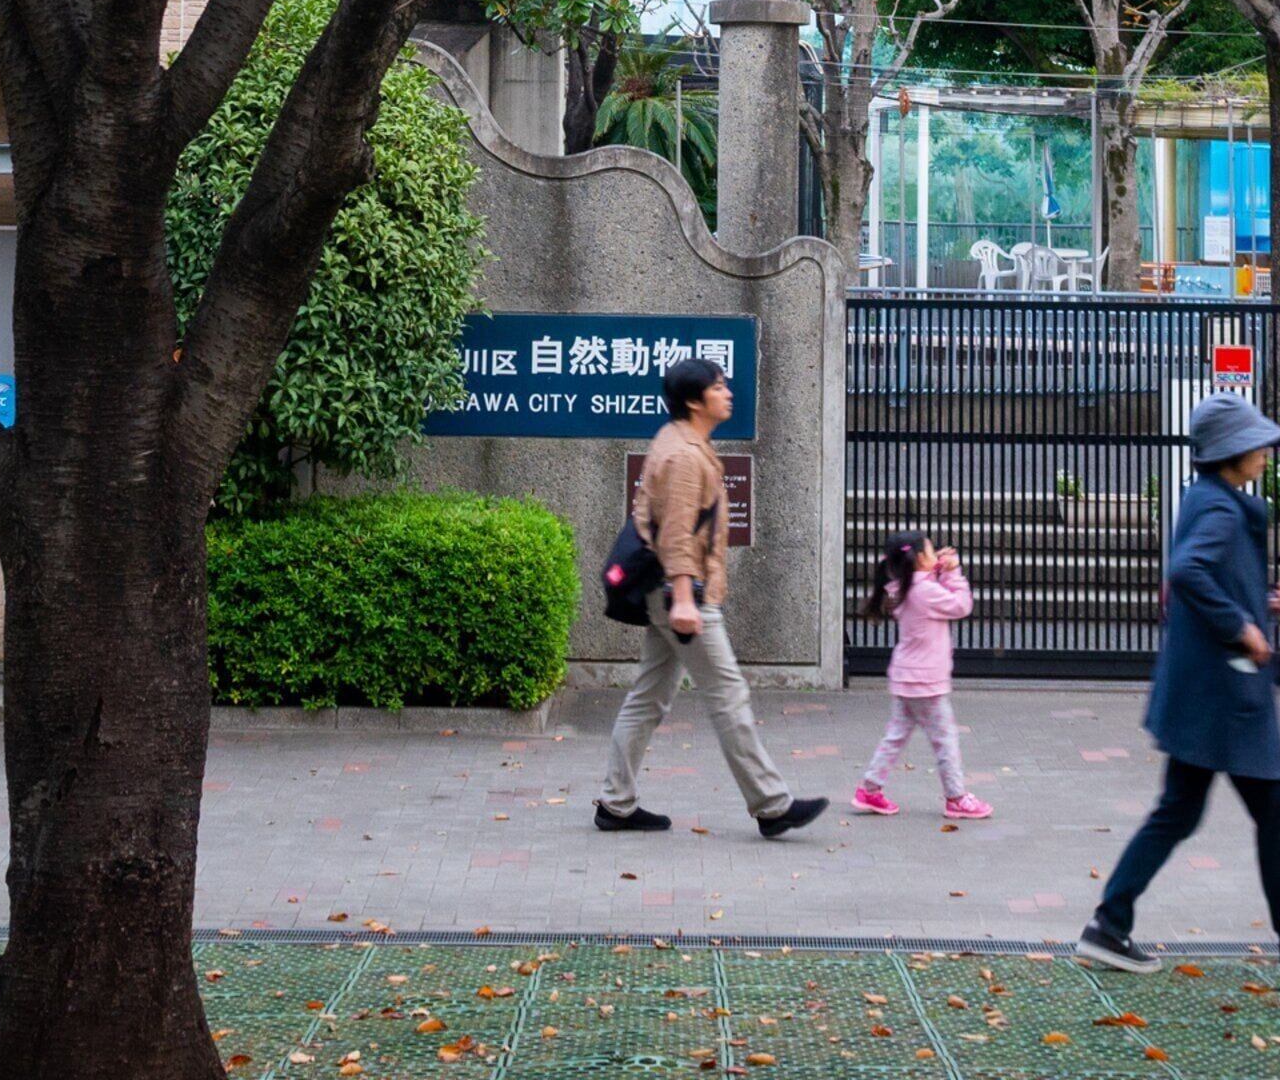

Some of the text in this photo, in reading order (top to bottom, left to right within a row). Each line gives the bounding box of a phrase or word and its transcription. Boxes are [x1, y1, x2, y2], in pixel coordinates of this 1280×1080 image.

[458, 335, 734, 378] 川区 自然動物園
[1216, 373, 1250, 382] SECOM
[528, 393, 578, 413] CITY
